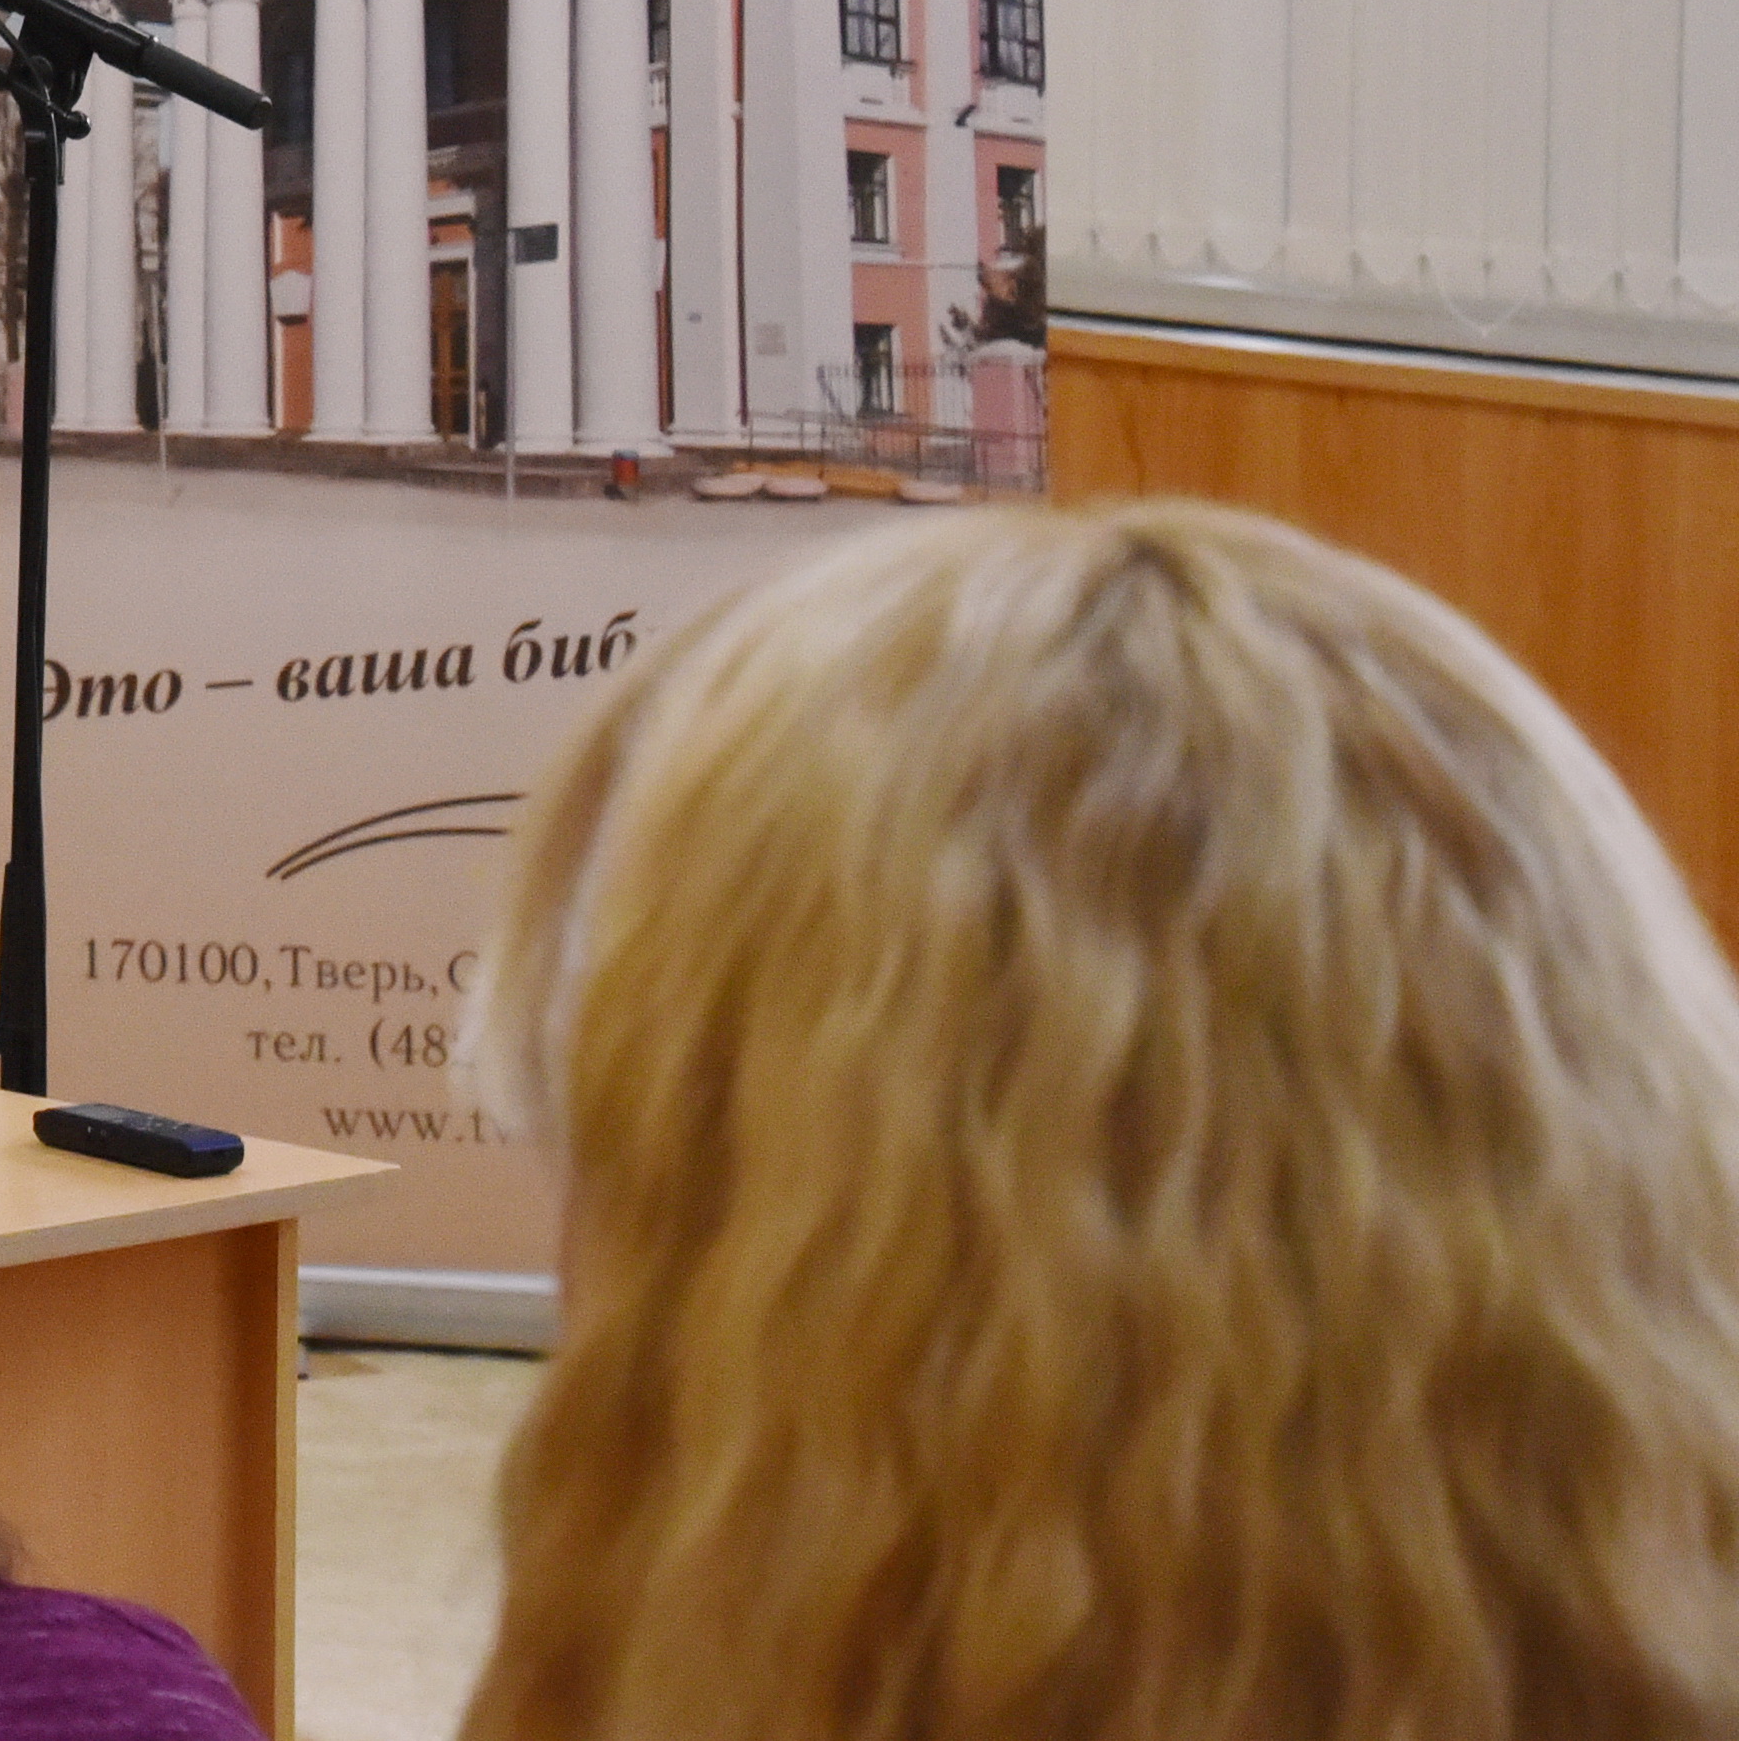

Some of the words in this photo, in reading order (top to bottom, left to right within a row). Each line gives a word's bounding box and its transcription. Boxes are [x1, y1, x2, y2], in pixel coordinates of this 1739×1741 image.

[41, 658, 183, 722] Это
[277, 645, 473, 701] ваша
[246, 1030, 341, 1063] тел.
[369, 1018, 473, 1070] (48
